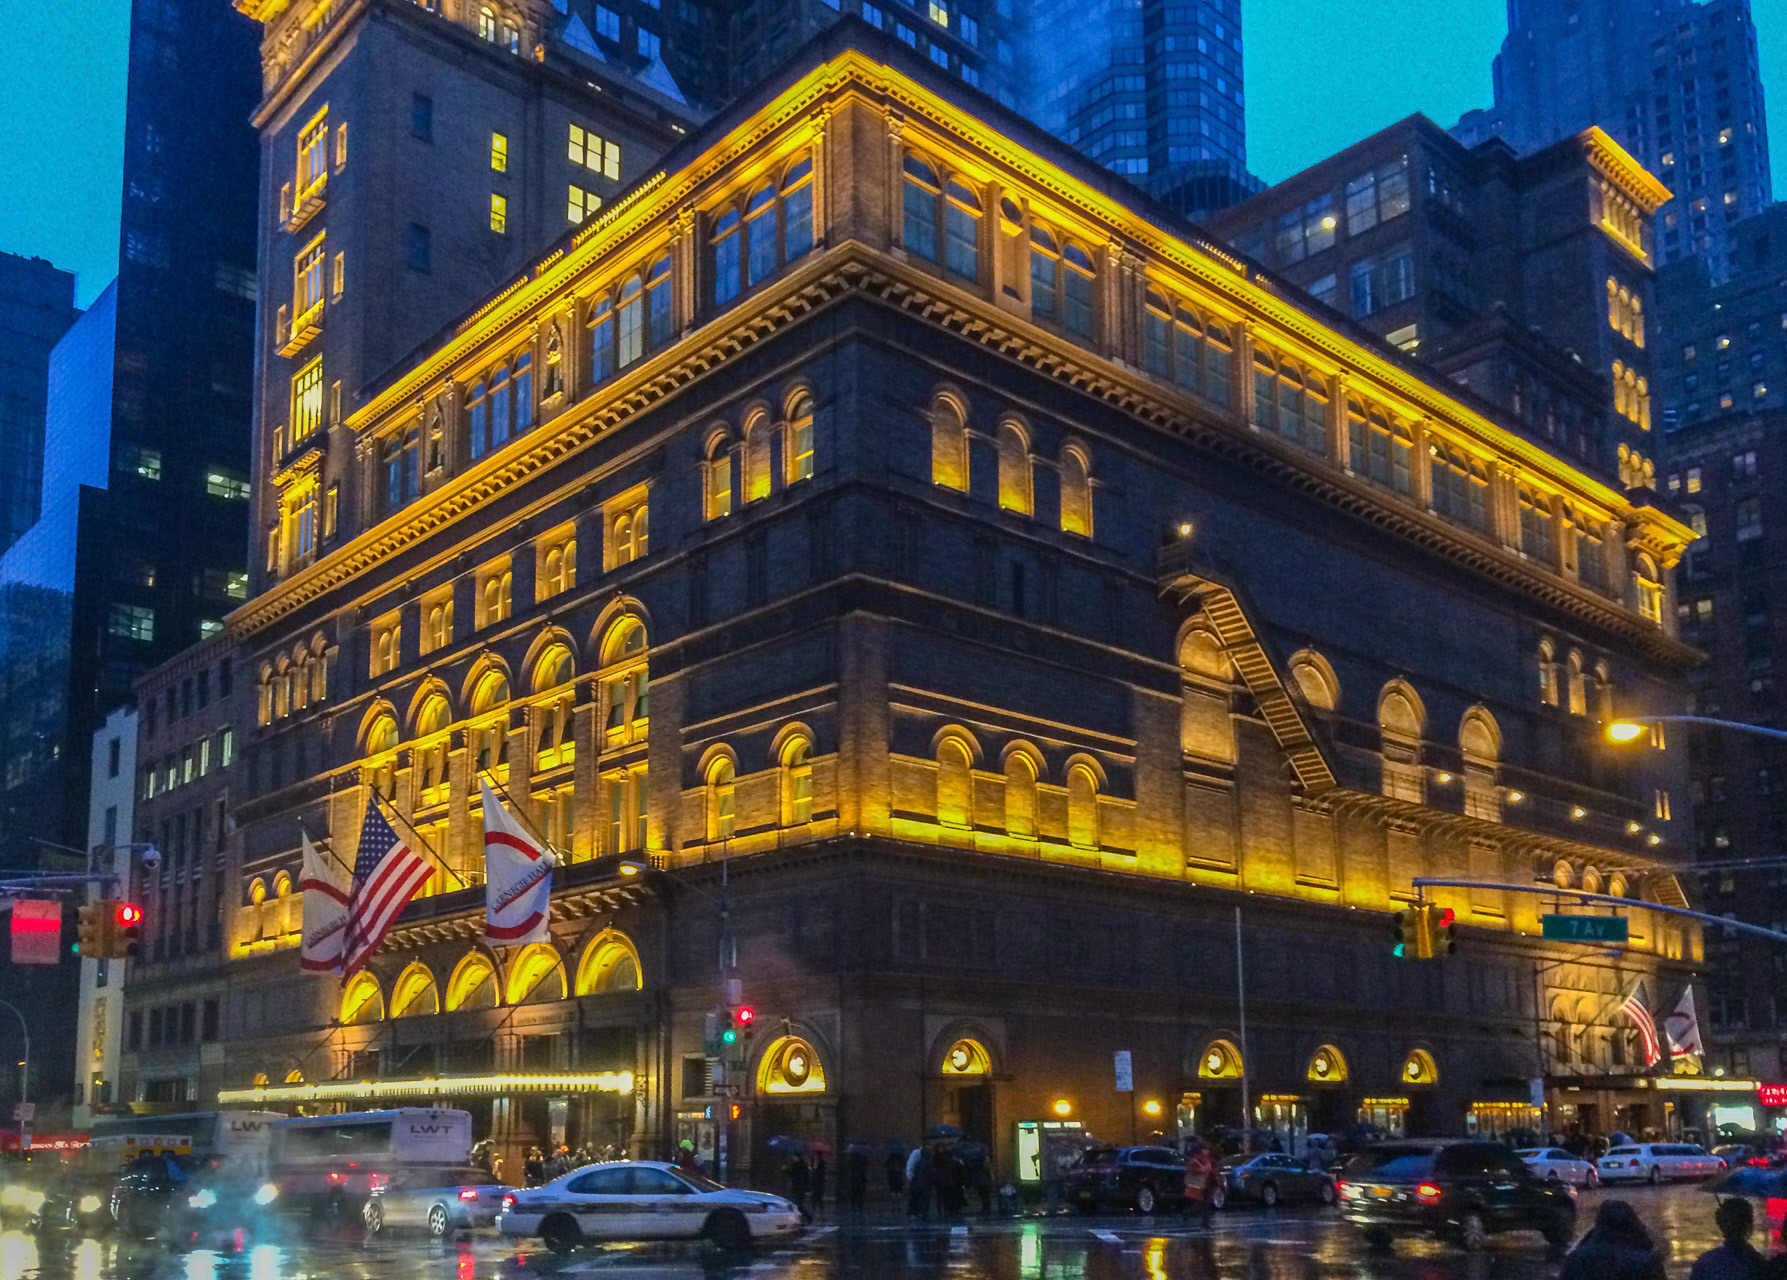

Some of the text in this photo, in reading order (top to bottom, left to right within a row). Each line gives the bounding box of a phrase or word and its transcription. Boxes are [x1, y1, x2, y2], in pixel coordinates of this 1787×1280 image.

[491, 876, 529, 909] CARNEGIE
[1569, 920, 1580, 936] 7
[410, 1124, 453, 1134] LWT
